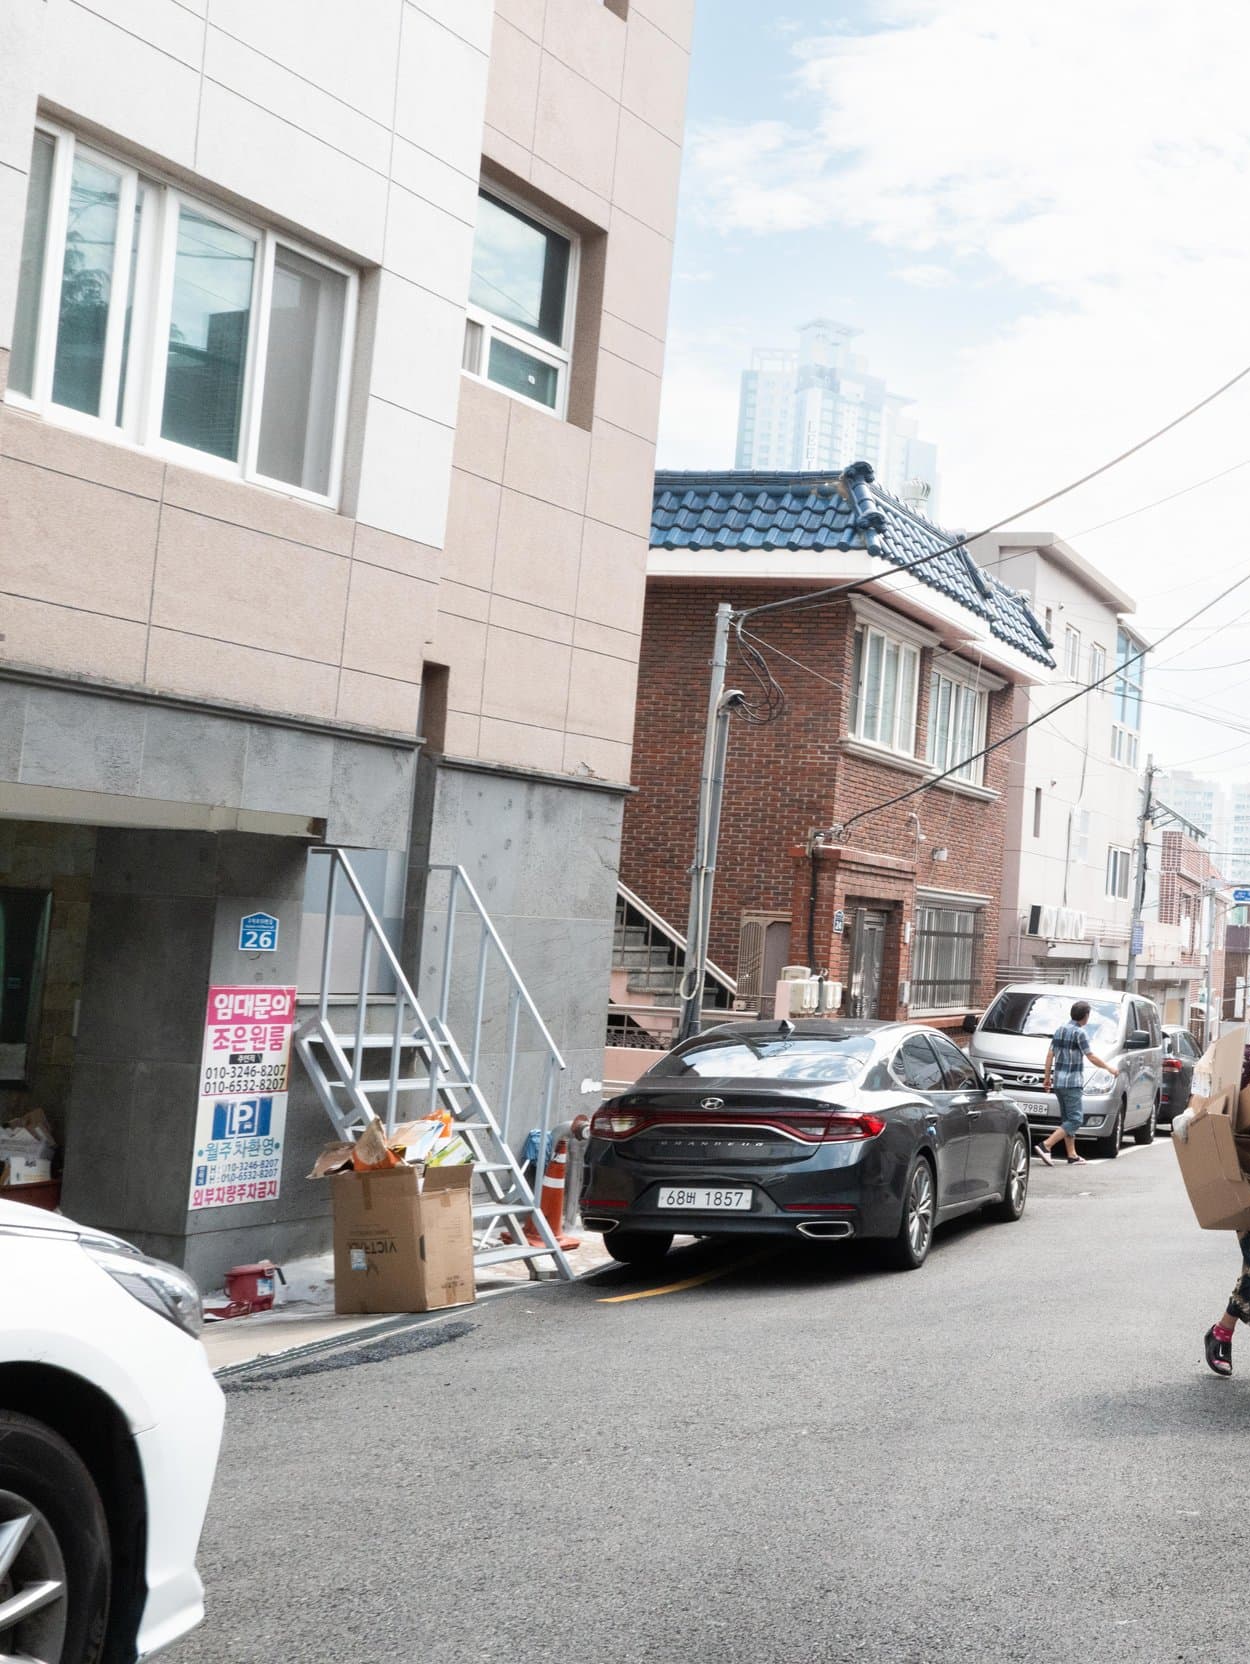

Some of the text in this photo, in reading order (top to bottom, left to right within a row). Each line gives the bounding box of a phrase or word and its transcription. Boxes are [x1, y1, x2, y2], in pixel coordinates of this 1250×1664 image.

[245, 931, 272, 948] 26
[214, 993, 291, 1020] 임대문의
[212, 1026, 285, 1053] 조은원룸
[205, 1064, 287, 1080] 010-3246-8207
[204, 1078, 285, 1094] 010-6532-8207
[1023, 1103, 1043, 1112] 7988
[205, 1137, 275, 1162] 월주차환영
[193, 1180, 278, 1207] 외부차량주차금지
[666, 1190, 744, 1207] 68버 1857
